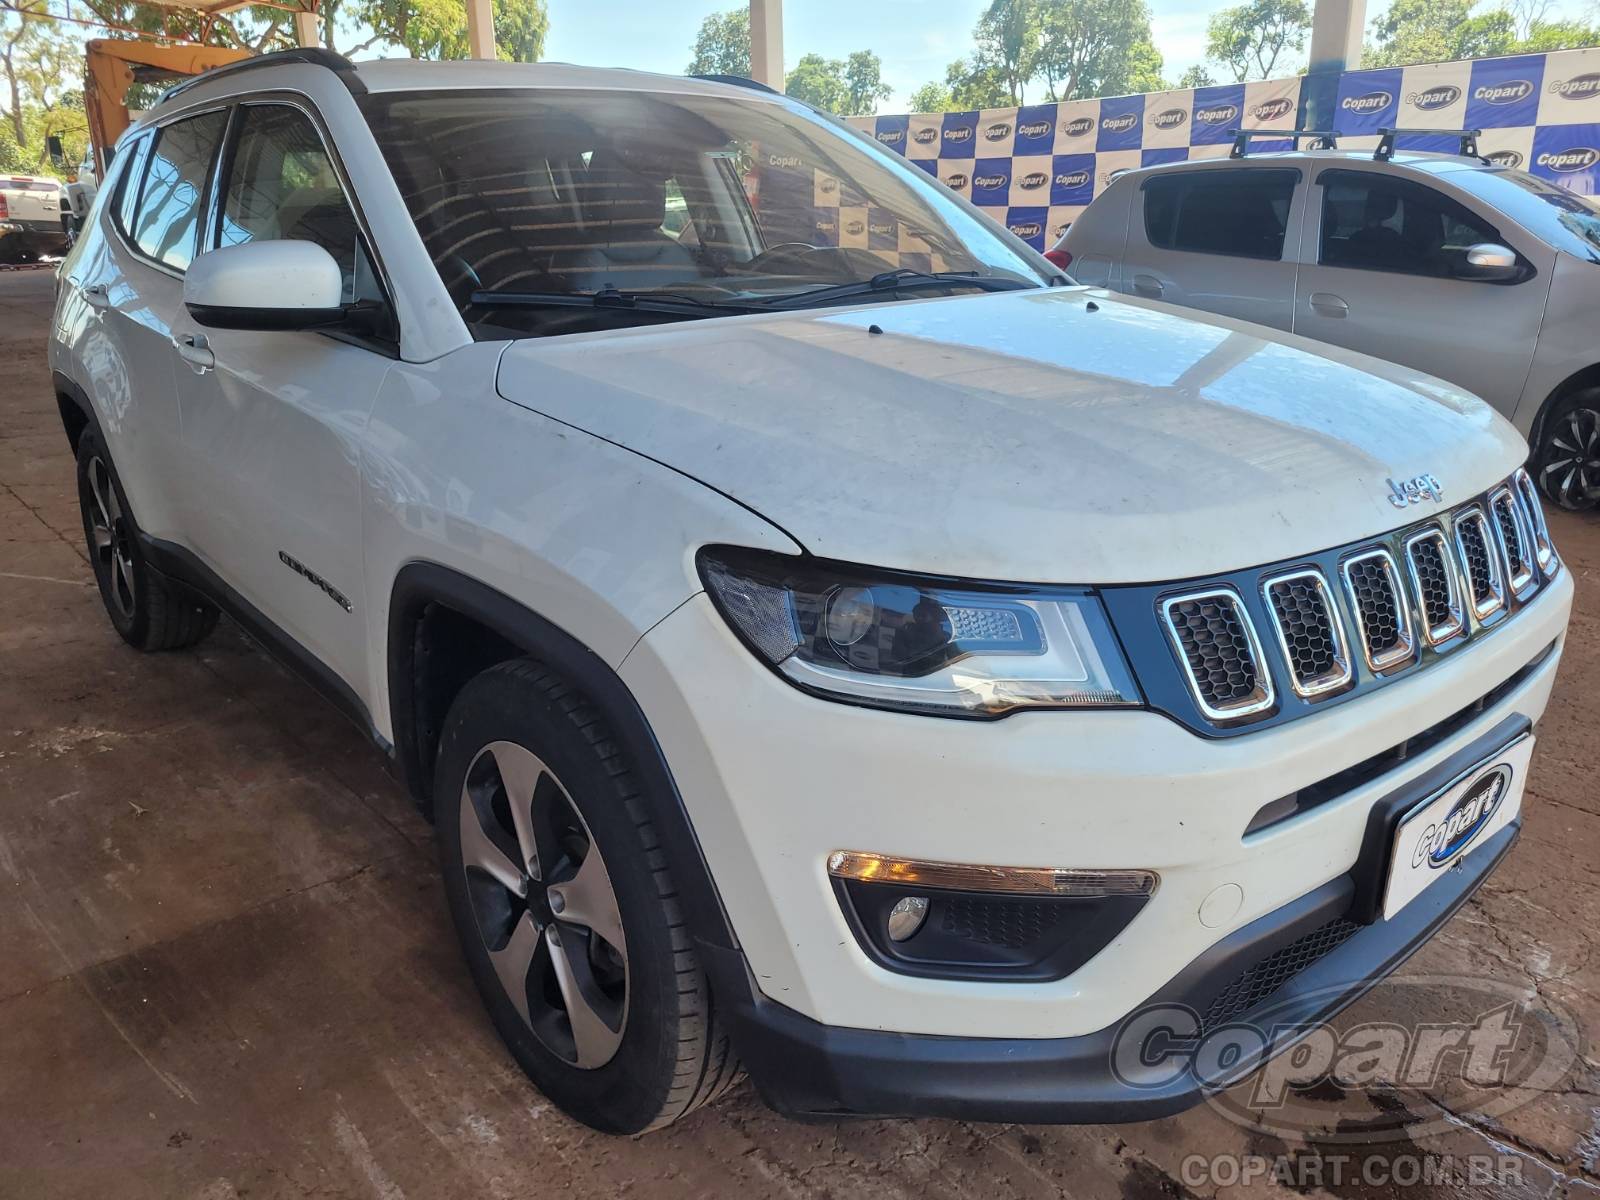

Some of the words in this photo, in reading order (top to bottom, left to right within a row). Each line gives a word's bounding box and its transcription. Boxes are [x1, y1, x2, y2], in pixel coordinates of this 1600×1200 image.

[1405, 90, 1453, 105] Copart
[1474, 84, 1526, 100] Copart
[1342, 95, 1386, 110] Copart
[1196, 109, 1233, 124] Copart
[1248, 103, 1289, 117] Copart
[1018, 123, 1047, 136] Copart
[1102, 116, 1134, 130] Copart
[877, 132, 902, 143] Copart
[943, 128, 969, 140] Copart
[983, 126, 1007, 138] opart
[1537, 152, 1593, 169] Copart
[943, 177, 965, 190] opart
[974, 177, 1004, 189] Copart
[1055, 174, 1086, 187] Copart
[1008, 224, 1038, 237] Copart
[1385, 473, 1443, 508] Jeep
[1412, 772, 1501, 869] Copart
